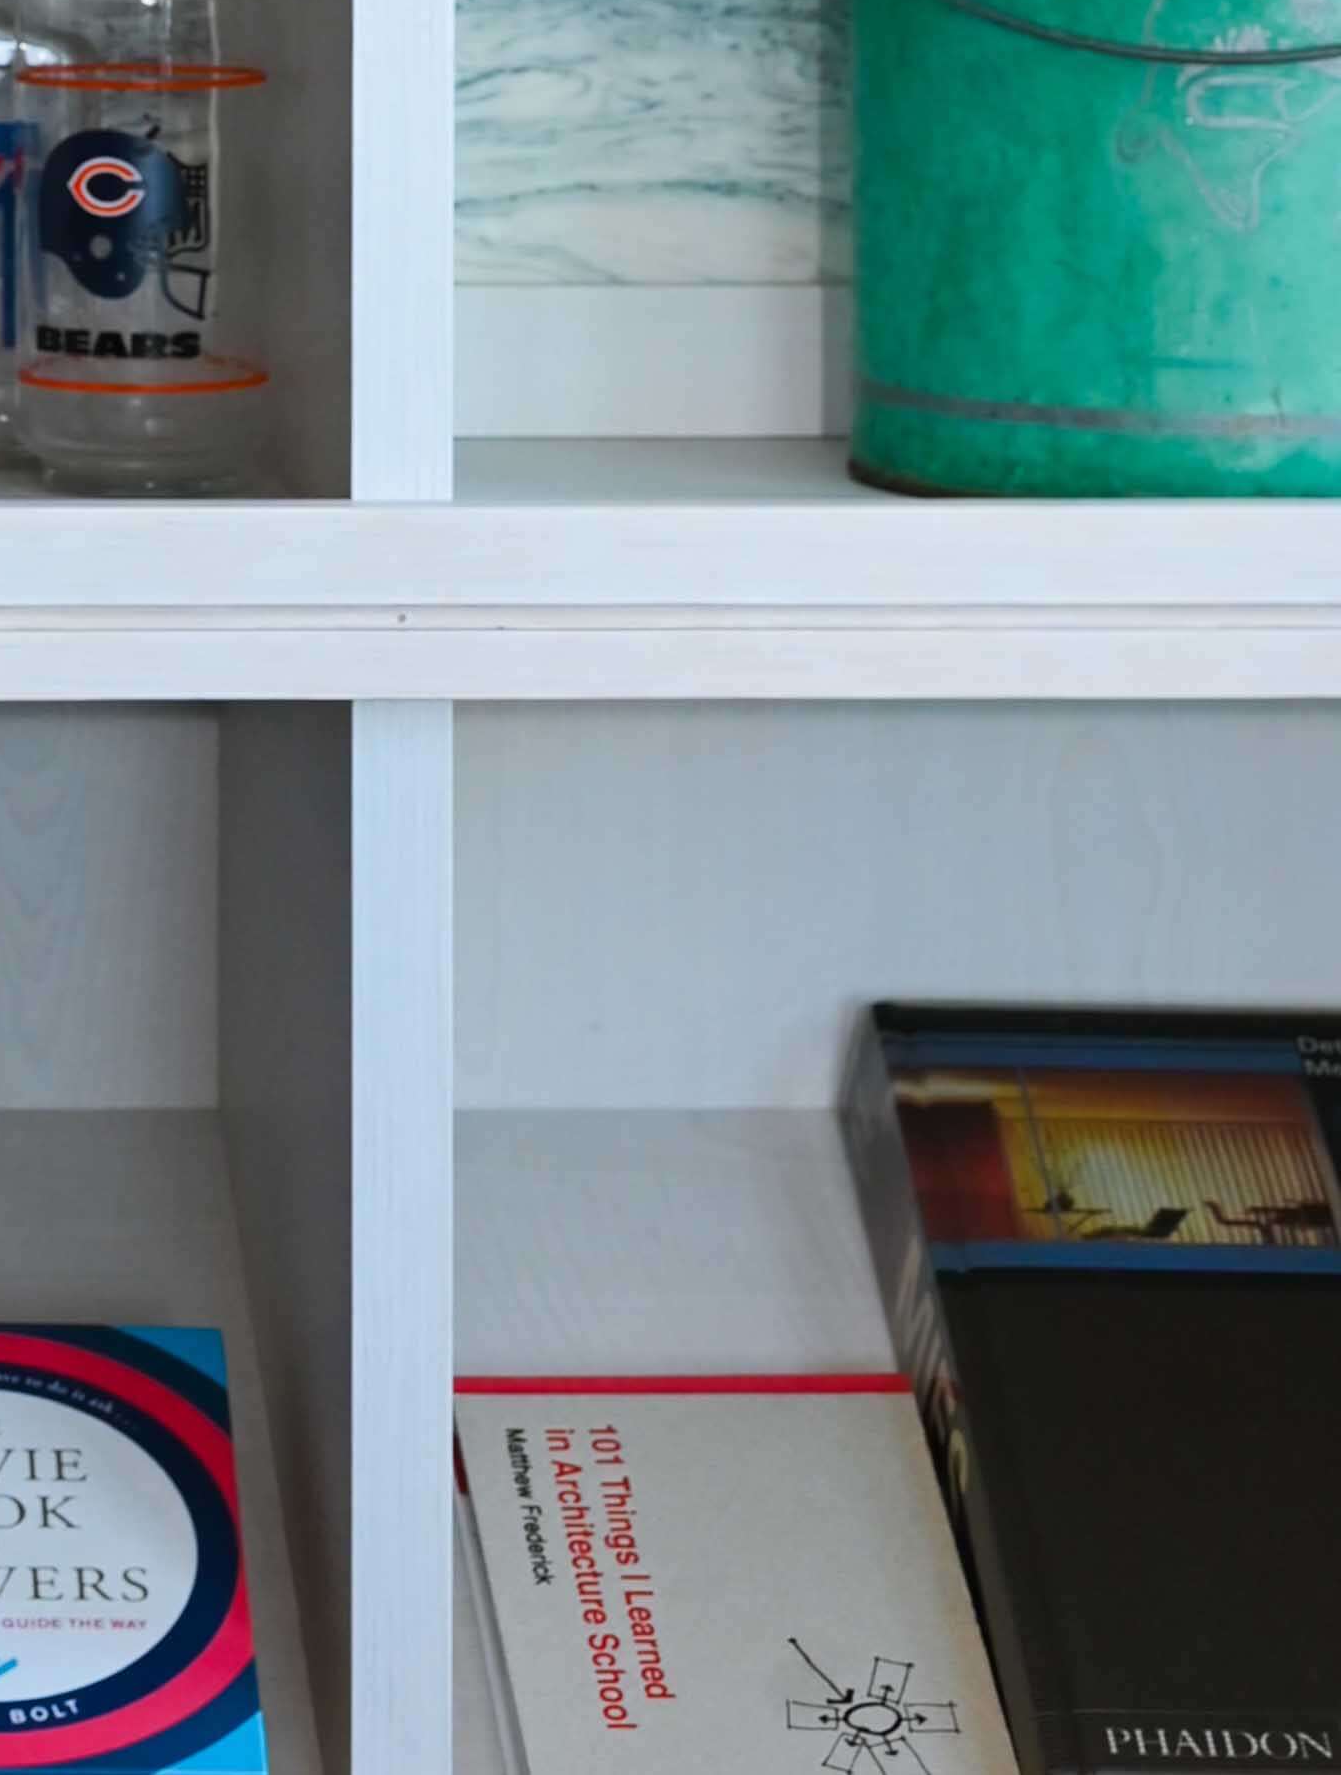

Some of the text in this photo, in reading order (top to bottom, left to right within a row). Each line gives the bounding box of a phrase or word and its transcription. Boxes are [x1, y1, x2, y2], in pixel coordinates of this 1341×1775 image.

[36, 326, 202, 359] BEARS
[588, 1425, 625, 1465] 101
[505, 1427, 554, 1586] Matthew Frederick
[600, 1475, 640, 1566] Things
[545, 1427, 638, 1729] in Architecture School
[2, 1617, 62, 1630] GUIDE
[69, 1618, 103, 1630] THE
[110, 1619, 148, 1631] WAY
[624, 1590, 677, 1699] Learned
[8, 1698, 80, 1725] BOLT
[1105, 1727, 1333, 1759] PHAIDON
